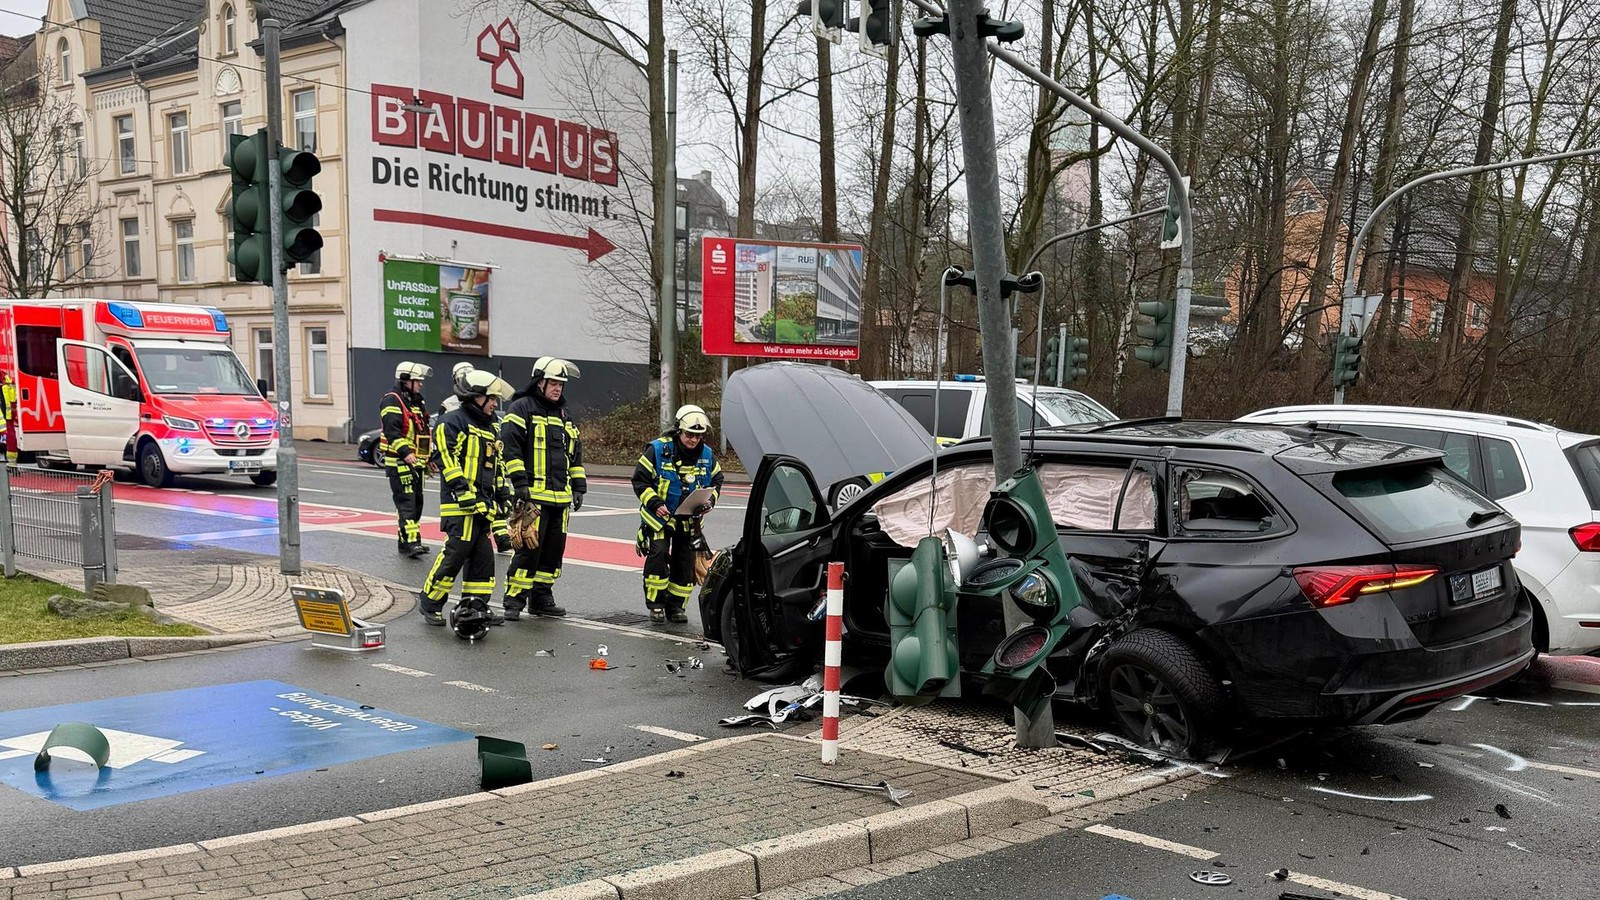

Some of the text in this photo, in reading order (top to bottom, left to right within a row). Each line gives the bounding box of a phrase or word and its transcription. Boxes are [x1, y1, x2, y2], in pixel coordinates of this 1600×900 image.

[377, 94, 614, 176] BAUHAUS
[372, 157, 619, 221] Die Richtung stimmt.
[797, 255, 815, 265] RUB
[393, 307, 415, 318] auch
[146, 314, 211, 326] FEUERWEHR
[397, 319, 432, 333] Dippen.
[764, 345, 784, 354] Weil's
[796, 347, 813, 355] mehr
[824, 348, 839, 356] Geld
[839, 349, 856, 357] geht.
[275, 691, 419, 732] überwachung
